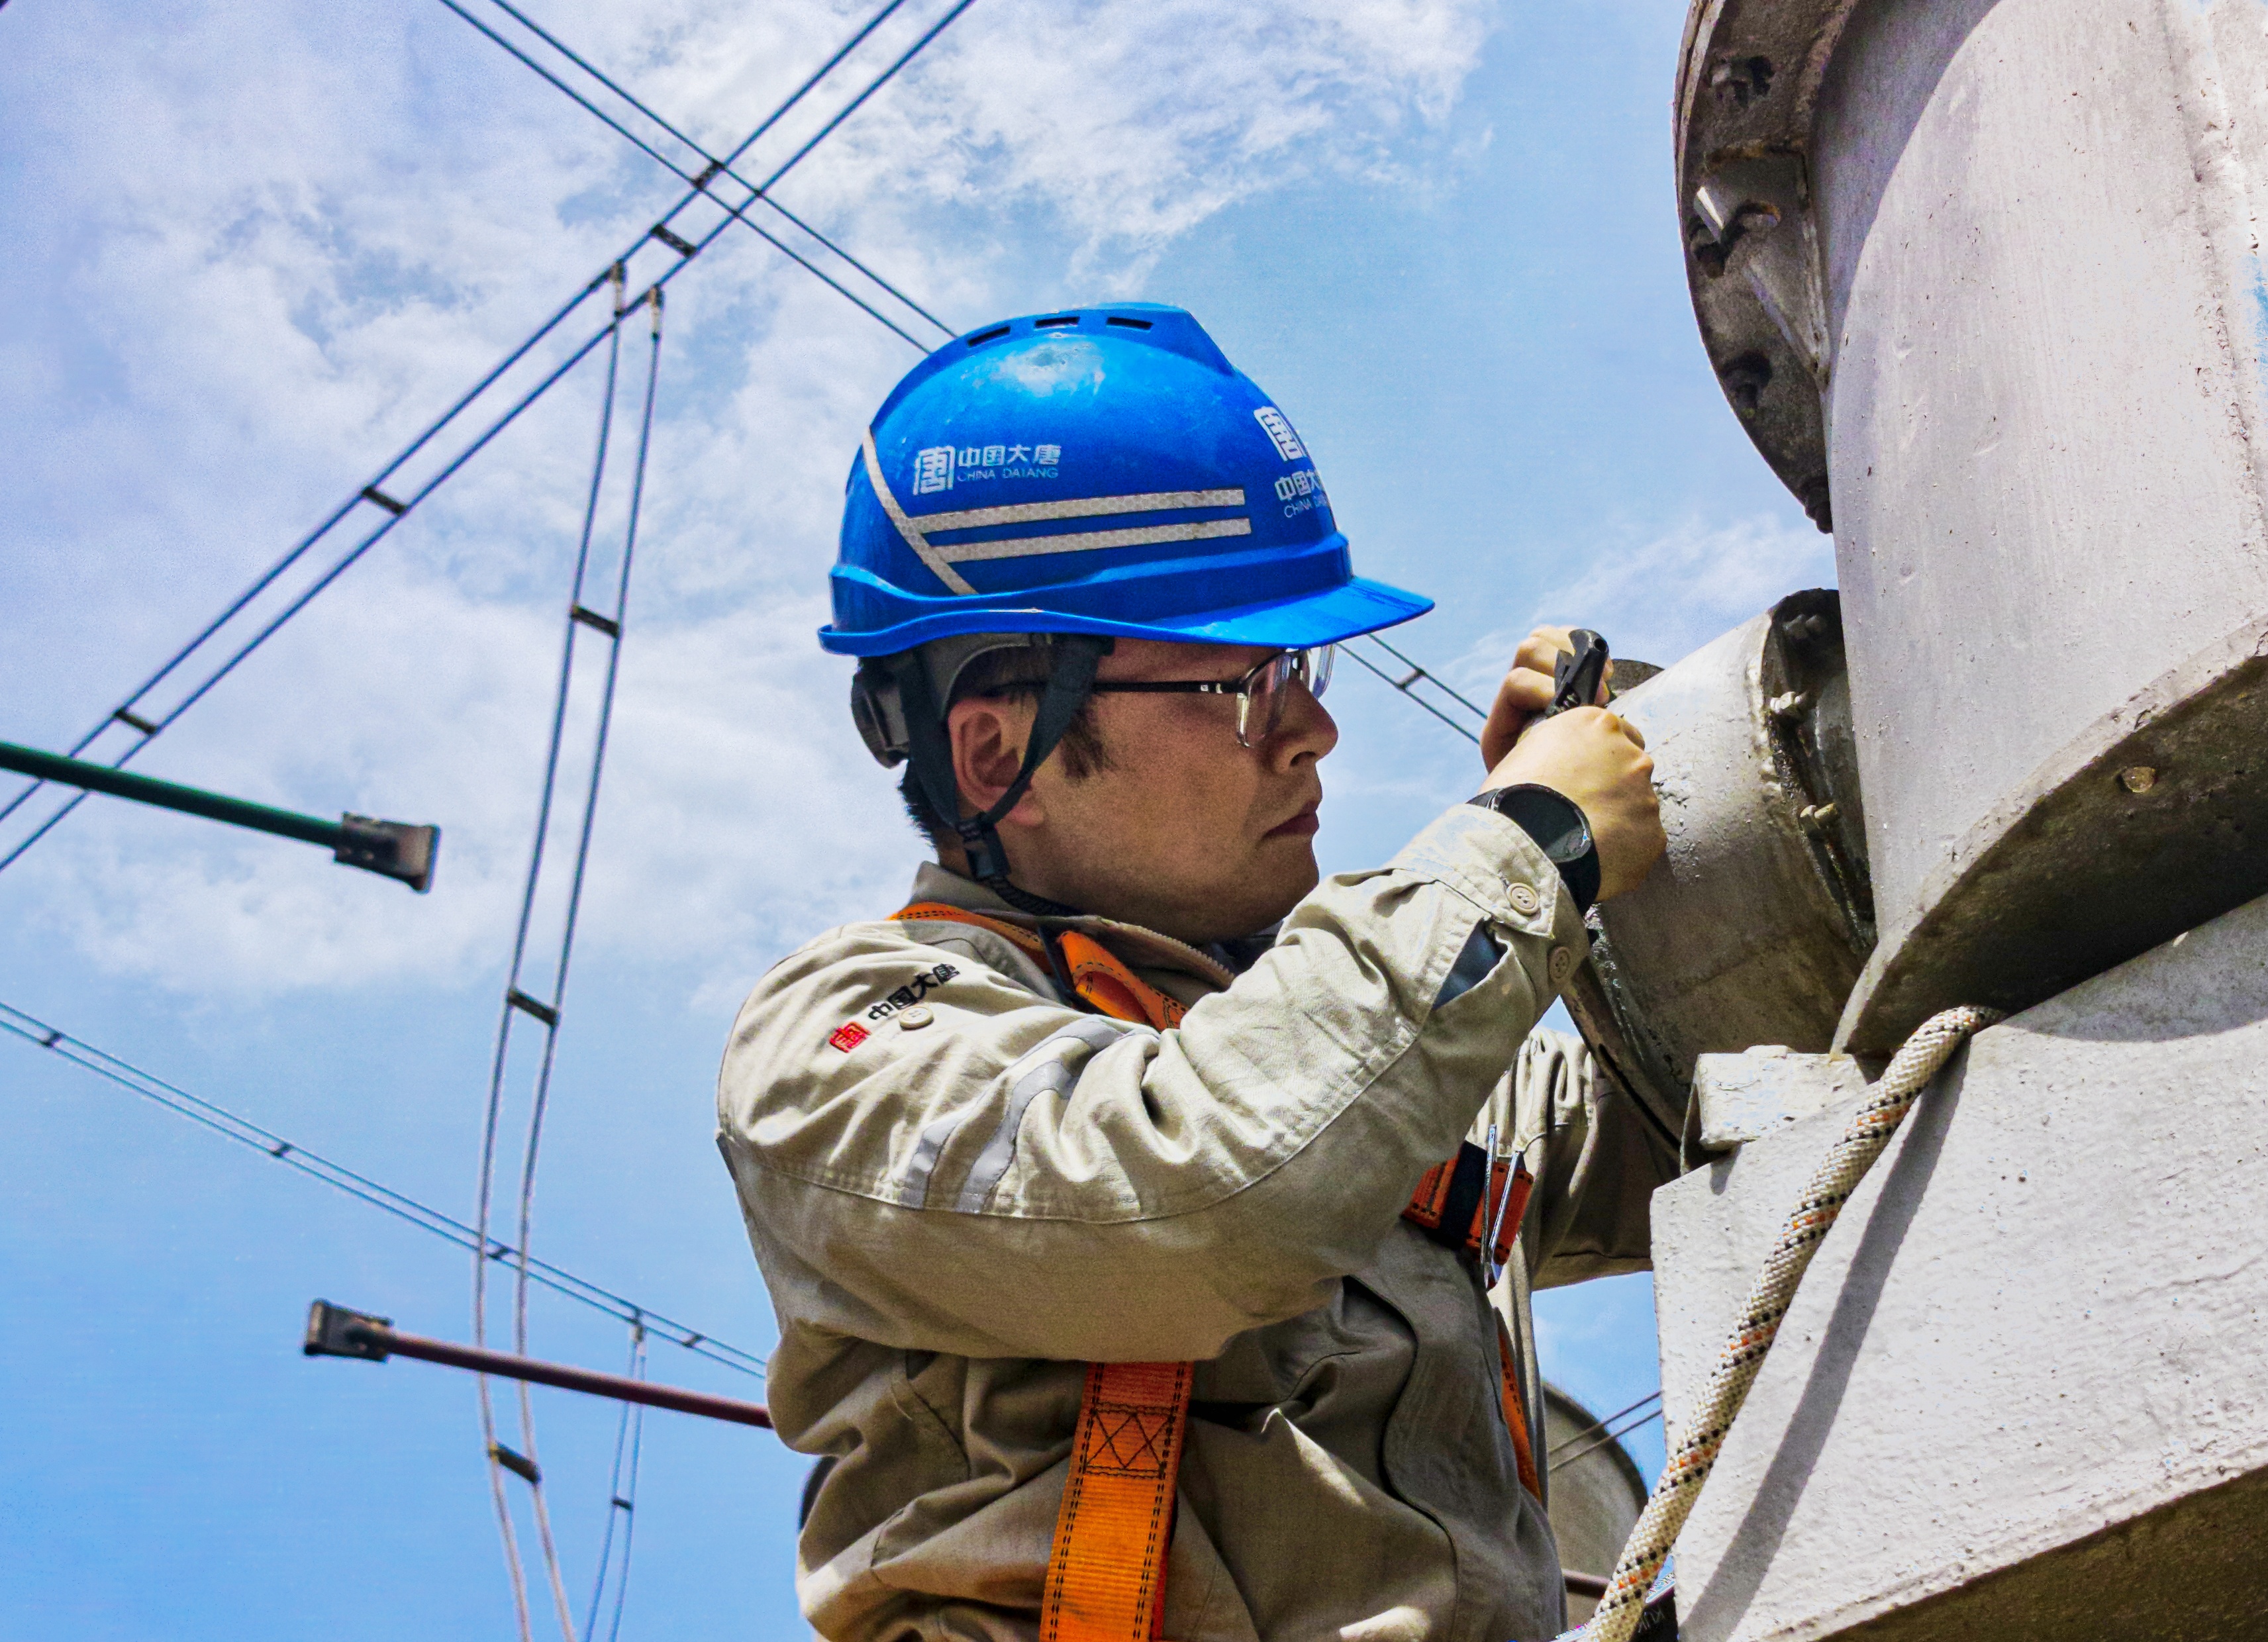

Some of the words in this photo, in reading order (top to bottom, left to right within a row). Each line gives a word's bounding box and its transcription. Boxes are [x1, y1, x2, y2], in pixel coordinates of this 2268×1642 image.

[958, 444, 1061, 467] 中国大唐
[957, 469, 997, 482] CHINA
[1274, 469, 1323, 501] 中国大
